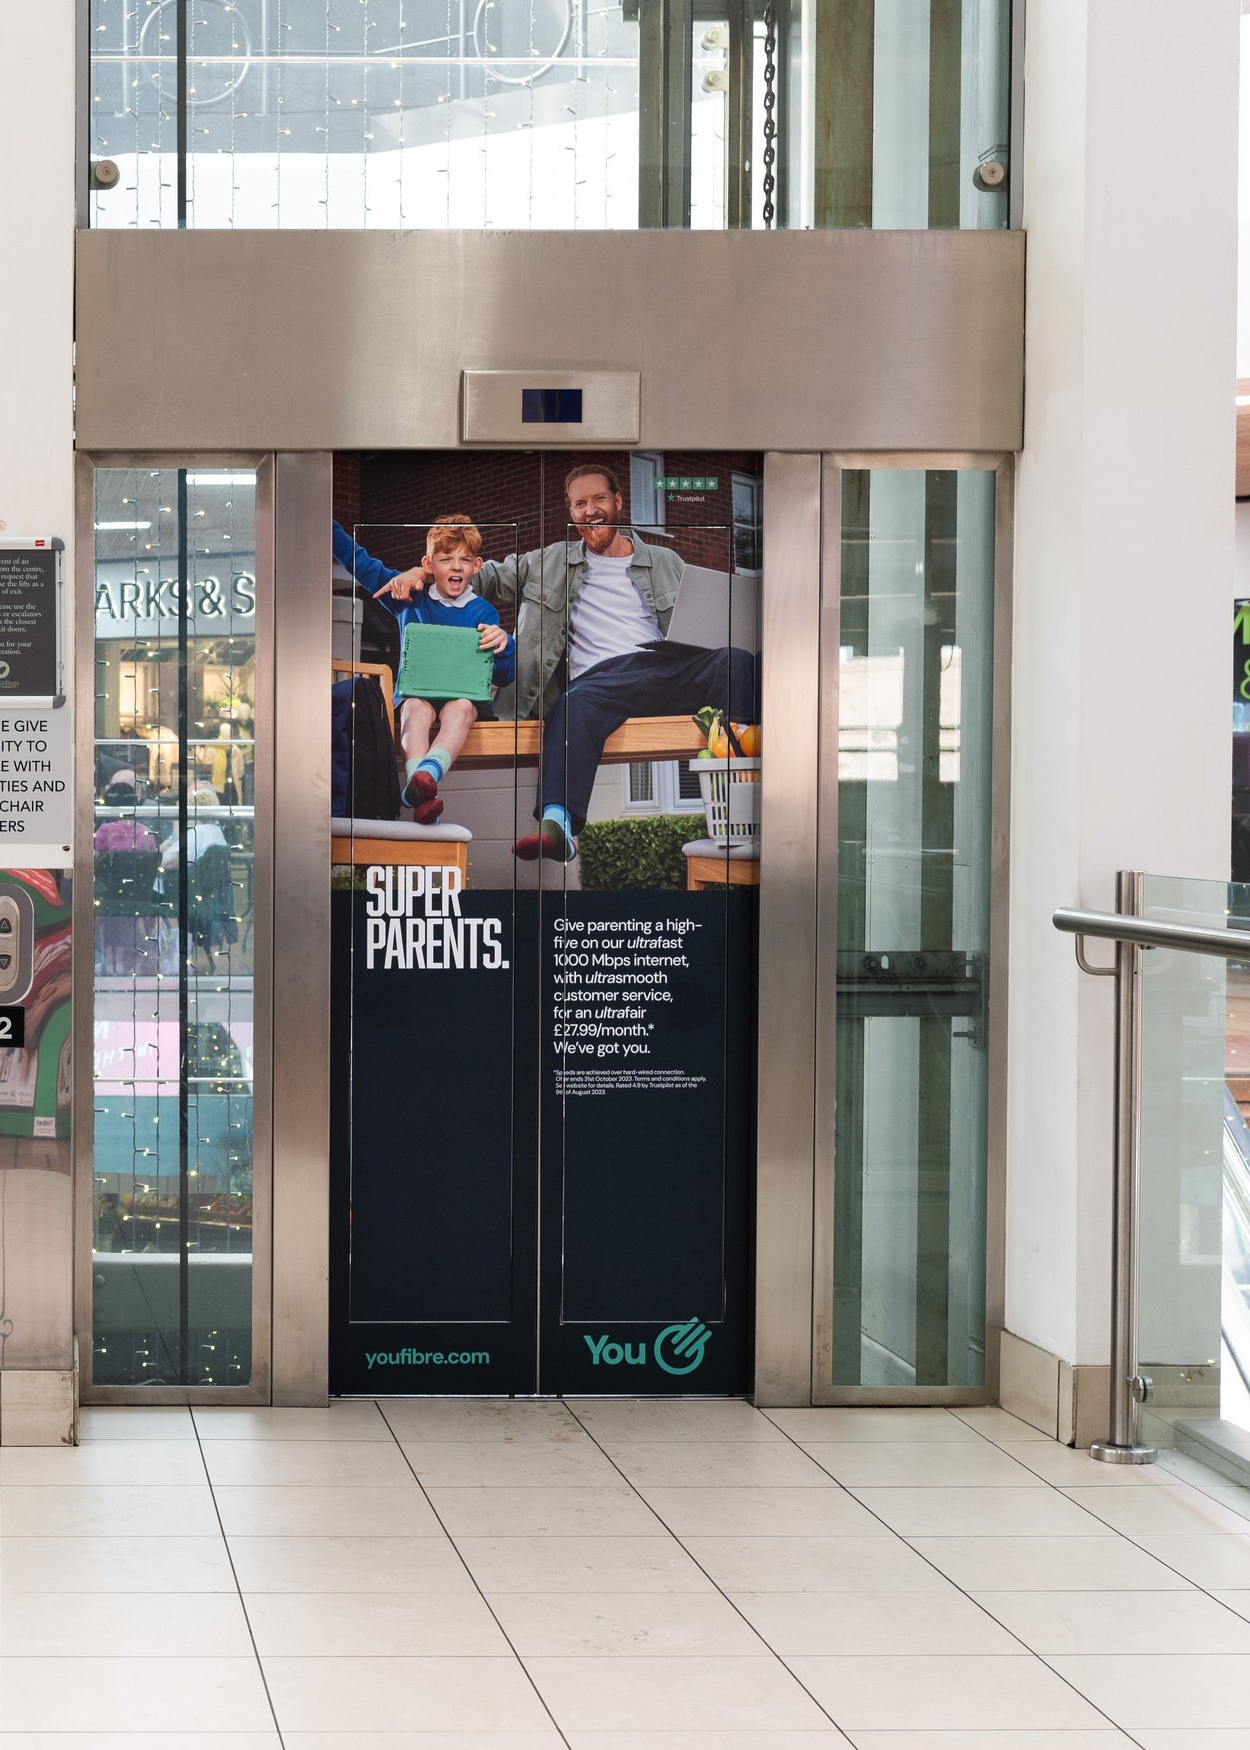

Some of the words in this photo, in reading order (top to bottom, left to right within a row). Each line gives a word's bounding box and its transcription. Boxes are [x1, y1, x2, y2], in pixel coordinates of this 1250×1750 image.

[23, 565, 44, 573] centre,
[1, 572, 24, 581] request
[95, 582, 191, 619] ARKS
[199, 578, 224, 615] &
[14, 720, 48, 732] GIVE
[26, 740, 47, 752] TO
[13, 760, 51, 772] WITH
[32, 780, 65, 792] AND
[366, 866, 462, 917] SUPER
[554, 918, 585, 931] Give
[588, 918, 652, 935] parenting
[655, 921, 663, 931] a
[366, 918, 510, 969] PARENTS.
[553, 936, 578, 949] five
[581, 939, 598, 949] on
[601, 939, 625, 949] our
[627, 936, 683, 949] ultrafast
[554, 953, 589, 966] 1000
[592, 953, 631, 970] Mbps
[634, 953, 689, 968] internet,
[553, 971, 582, 984] with
[585, 971, 667, 984] ultrasmooth
[554, 990, 619, 1001] customer
[622, 988, 673, 1003] service,
[553, 1006, 573, 1019] for
[575, 1009, 592, 1019] an
[595, 1006, 647, 1019] ultrafair
[553, 1041, 594, 1054] We've
[597, 1042, 620, 1057] got
[622, 1044, 651, 1057] you.
[583, 1335, 646, 1365] You
[365, 1348, 489, 1369] youfibre.com
